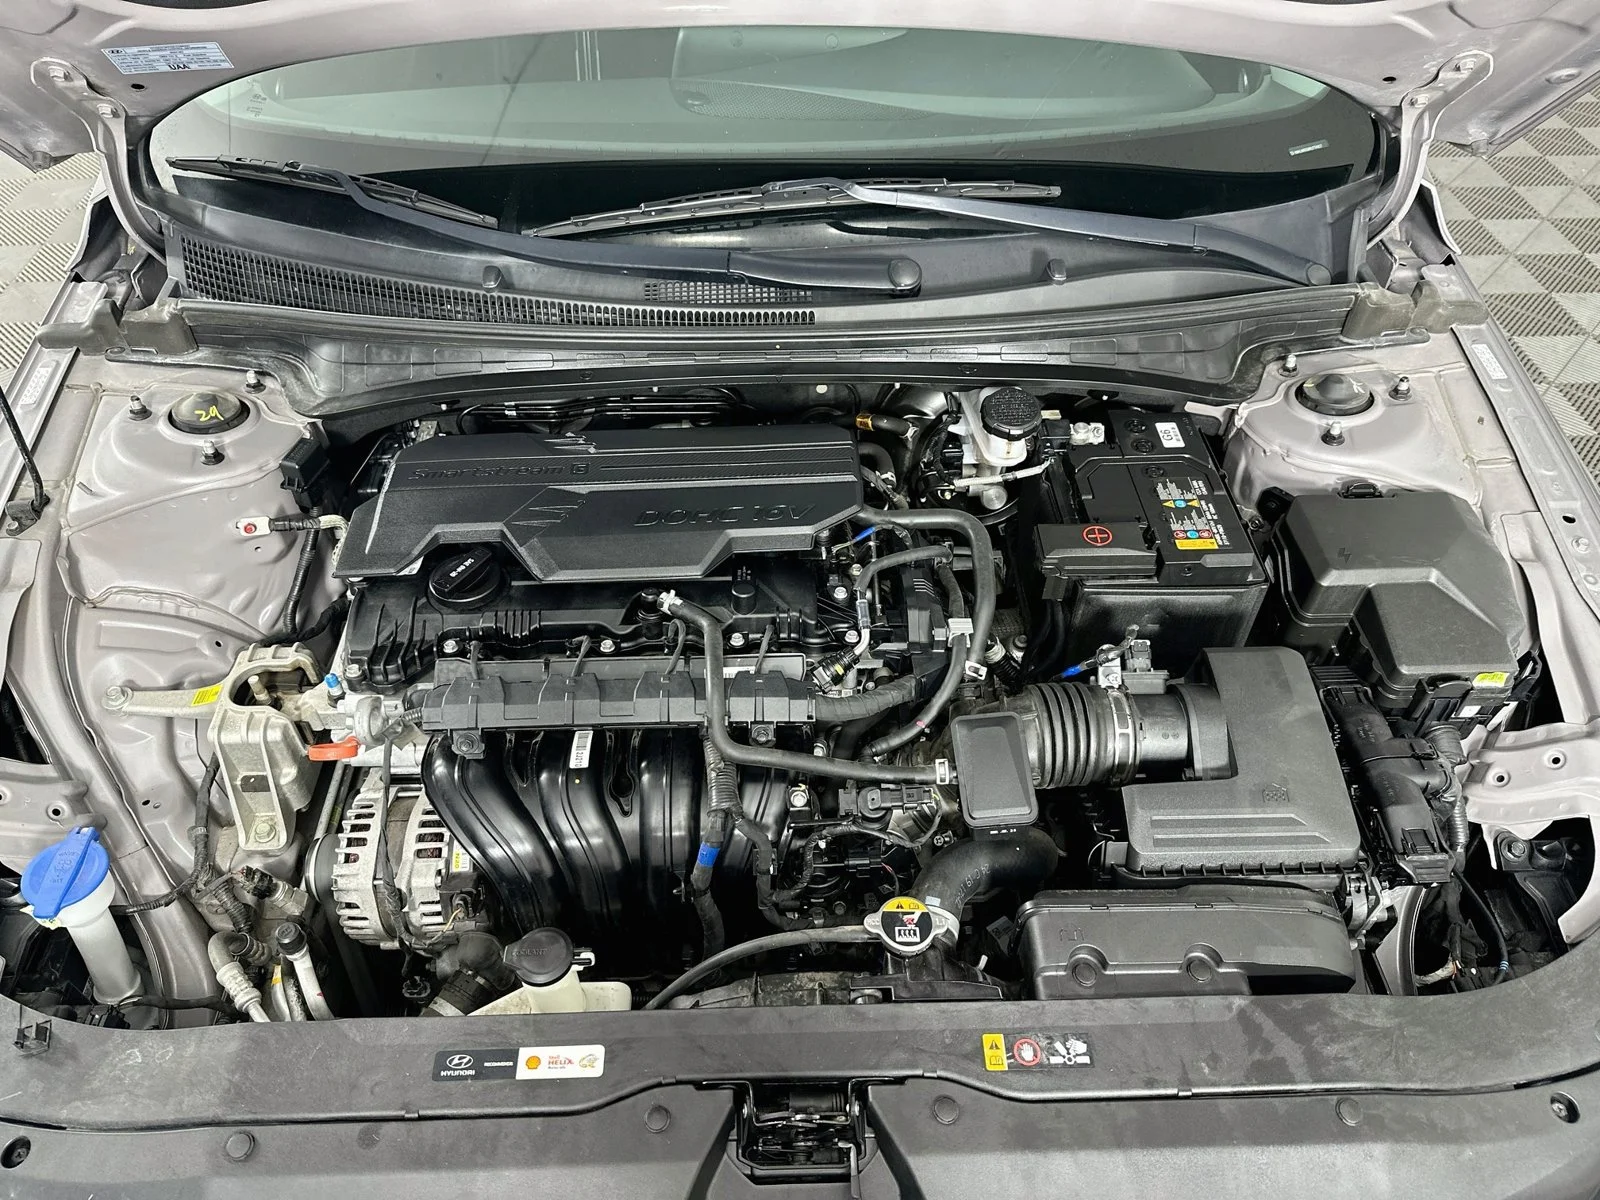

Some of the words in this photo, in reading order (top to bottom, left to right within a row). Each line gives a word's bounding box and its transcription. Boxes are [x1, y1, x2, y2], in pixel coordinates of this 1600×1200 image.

[168, 63, 191, 71] UAA
[1161, 429, 1173, 441] G6
[408, 466, 565, 480] Smartstream
[633, 506, 745, 527] DOHC
[753, 503, 816, 521] 16V
[548, 1057, 574, 1066] HELIX
[440, 1069, 476, 1077] HYUNDAI
